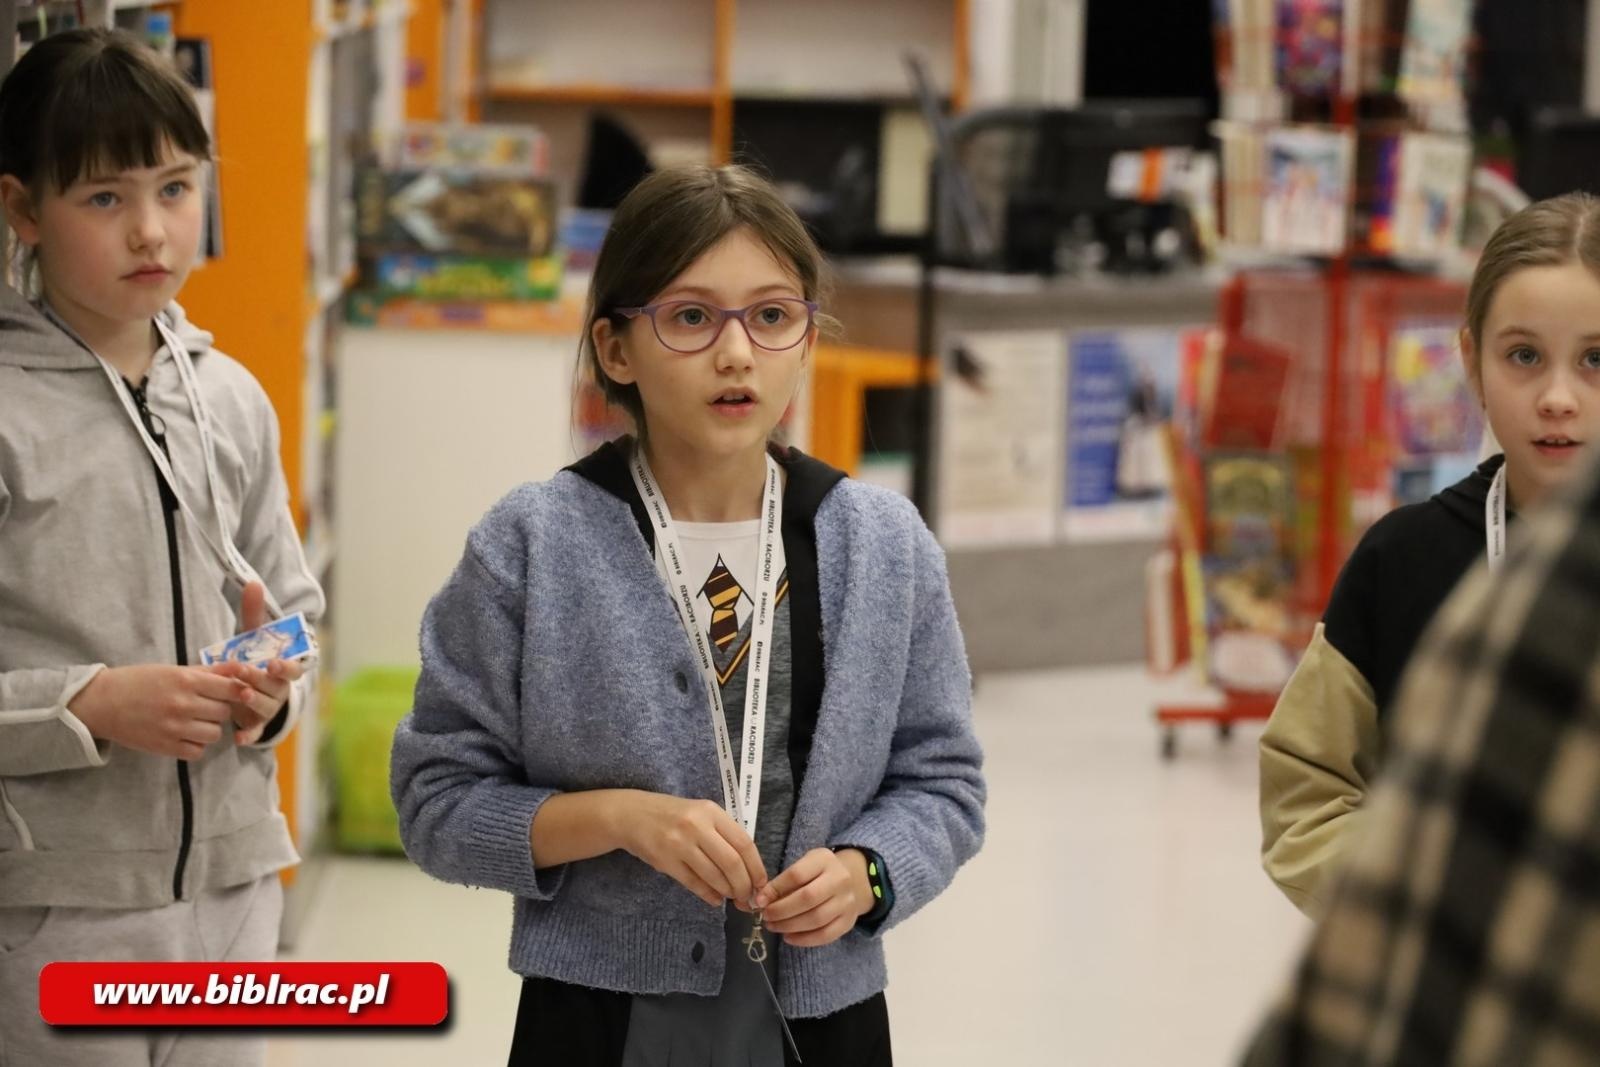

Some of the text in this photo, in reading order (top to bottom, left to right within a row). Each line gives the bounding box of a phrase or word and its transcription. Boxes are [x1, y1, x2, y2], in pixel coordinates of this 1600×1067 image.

[636, 464, 655, 497] BIBLIOTEKA
[767, 500, 776, 534] BIBLIOTEKA
[763, 543, 773, 582] RACIBORZU
[680, 585, 696, 623] RACIBORZU
[695, 632, 709, 669] BIBLIOTEKA
[752, 678, 760, 716] BIBLIOTEKA
[747, 725, 756, 764] RACIBORZU
